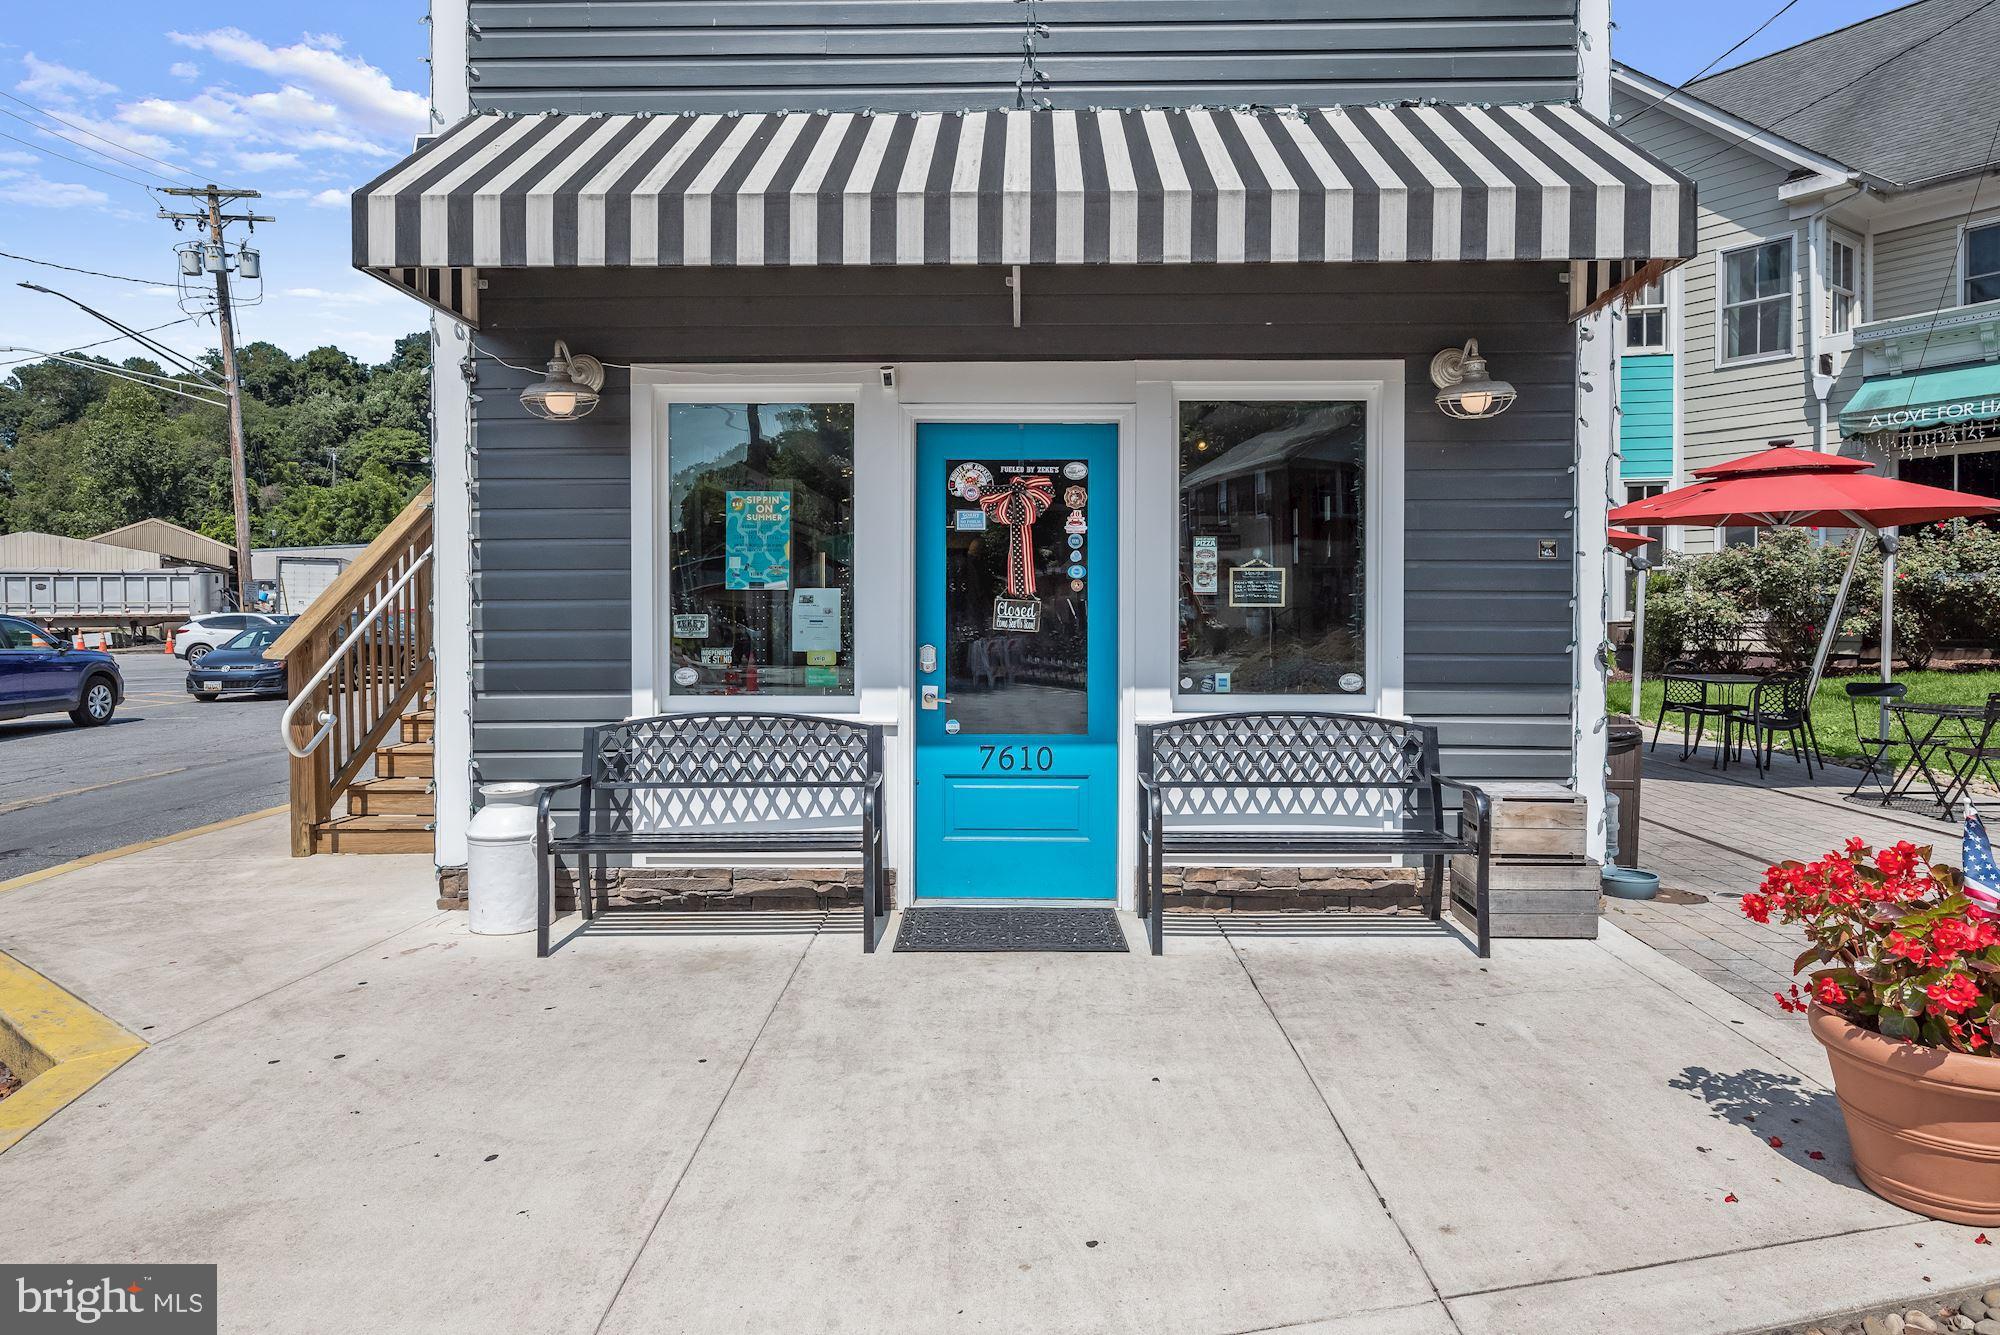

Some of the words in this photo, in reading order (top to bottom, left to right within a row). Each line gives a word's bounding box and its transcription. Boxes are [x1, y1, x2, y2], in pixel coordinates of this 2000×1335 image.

[1868, 414, 1882, 428] A
[1888, 407, 1931, 426] LOVE
[1937, 402, 1975, 419] FOR
[1000, 465, 1025, 473] FUELED
[1026, 466, 1035, 474] BY
[1036, 466, 1060, 474] ZEKE'S
[746, 495, 783, 505] SIPPIN'
[755, 504, 773, 513] ON
[746, 513, 783, 521] SUMMER
[997, 601, 1036, 618] Closed
[701, 655, 712, 664] WE
[813, 655, 826, 663] yelp
[979, 744, 1053, 771] 7610
